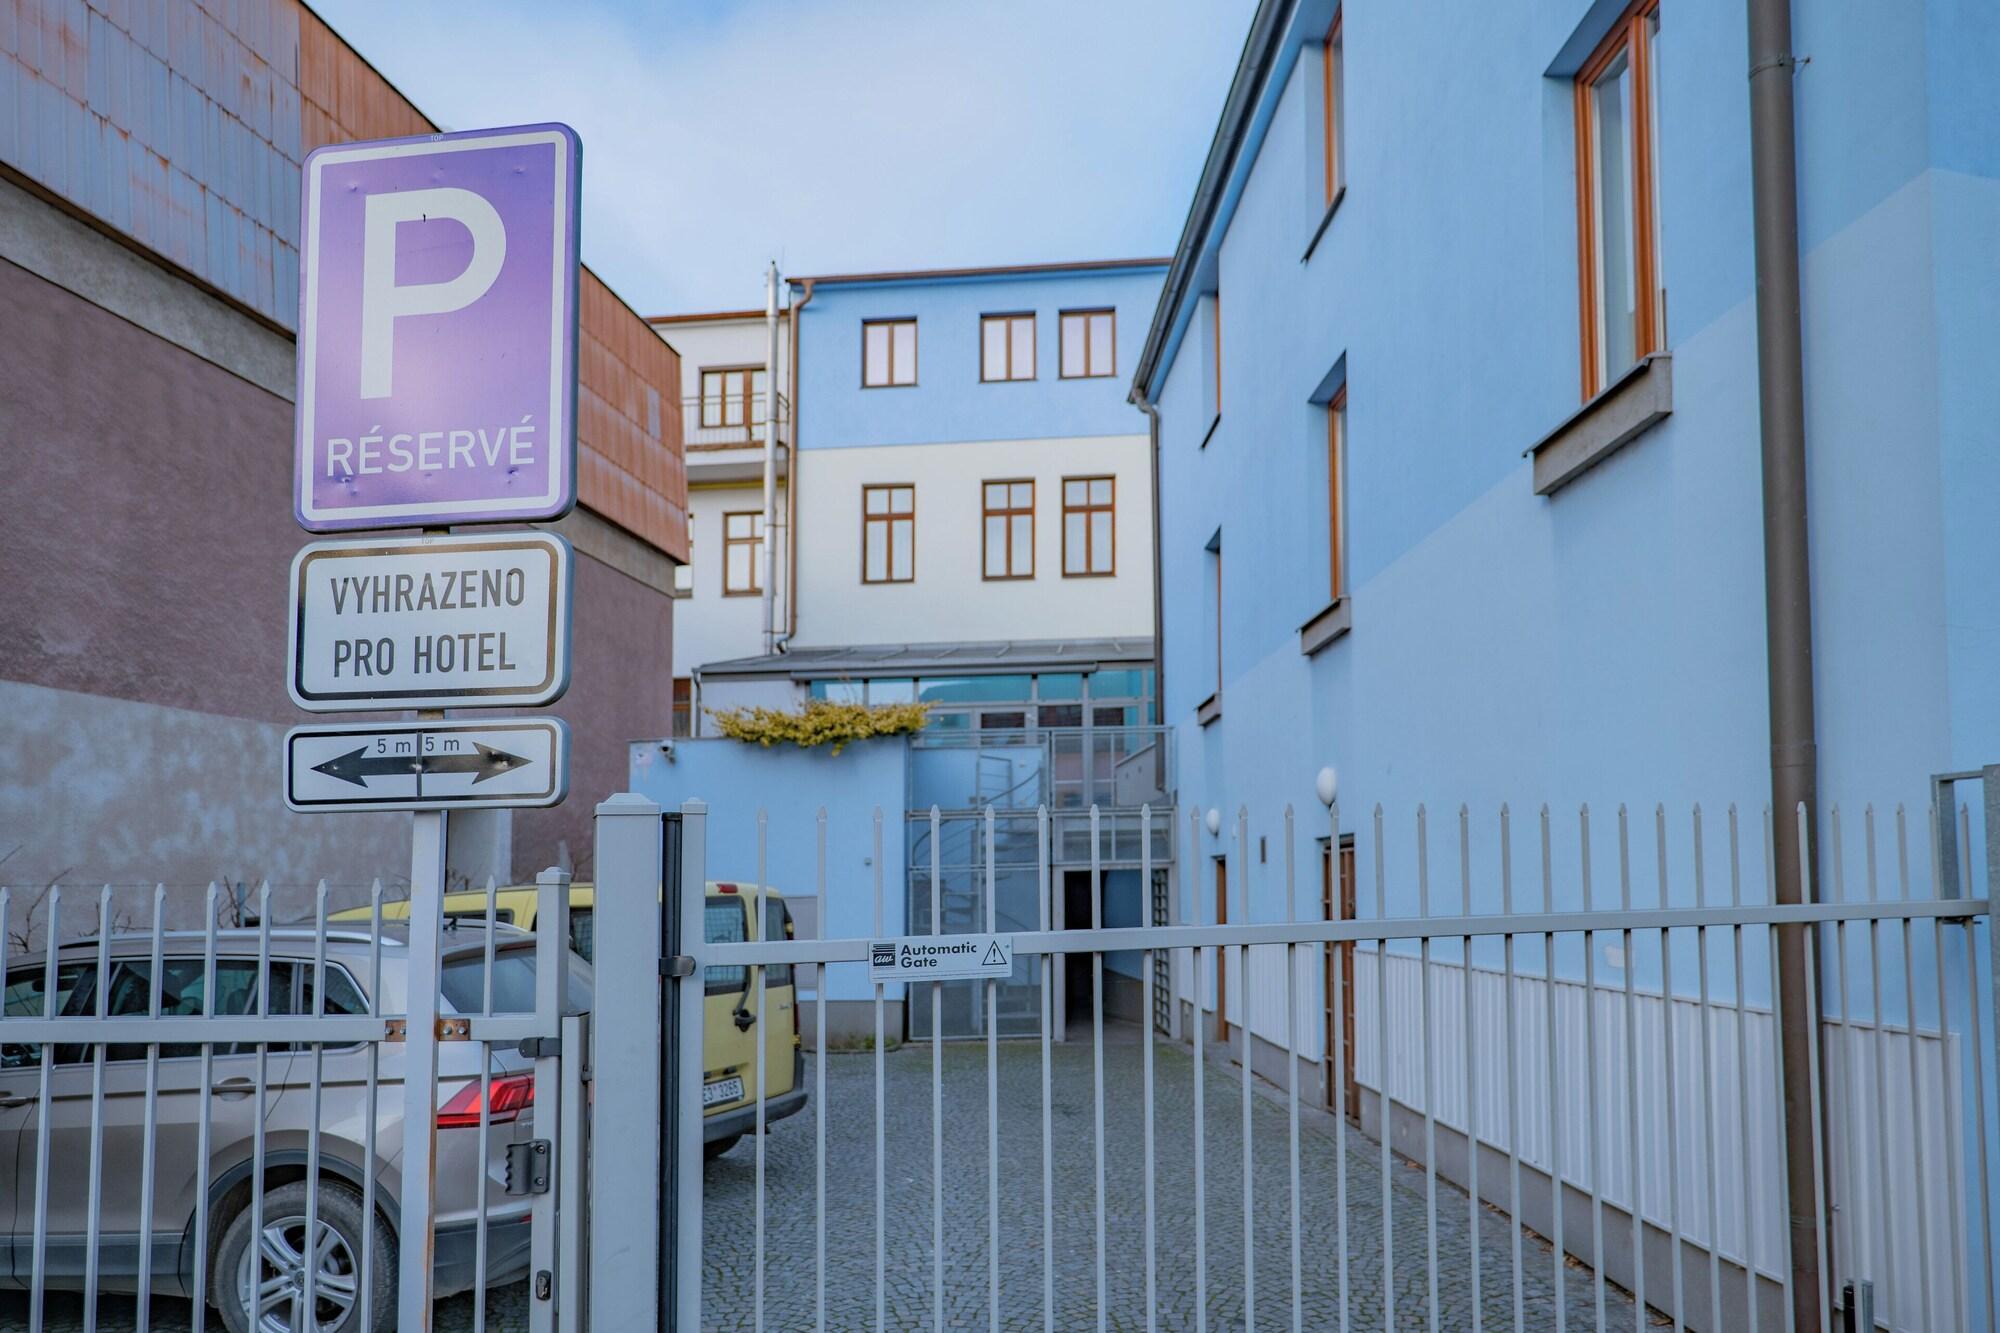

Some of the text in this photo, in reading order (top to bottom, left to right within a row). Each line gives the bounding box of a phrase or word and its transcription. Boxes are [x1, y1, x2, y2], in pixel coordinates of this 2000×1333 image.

[360, 187, 507, 400] P
[326, 414, 536, 477] RÉSERVÉ
[330, 567, 526, 615] VYHRAZENO
[333, 631, 516, 678] PRO HOTEL
[376, 738, 411, 754] 5 m
[425, 736, 460, 751] 5 m
[900, 941, 977, 956] Automatic
[901, 957, 938, 968] Gate
